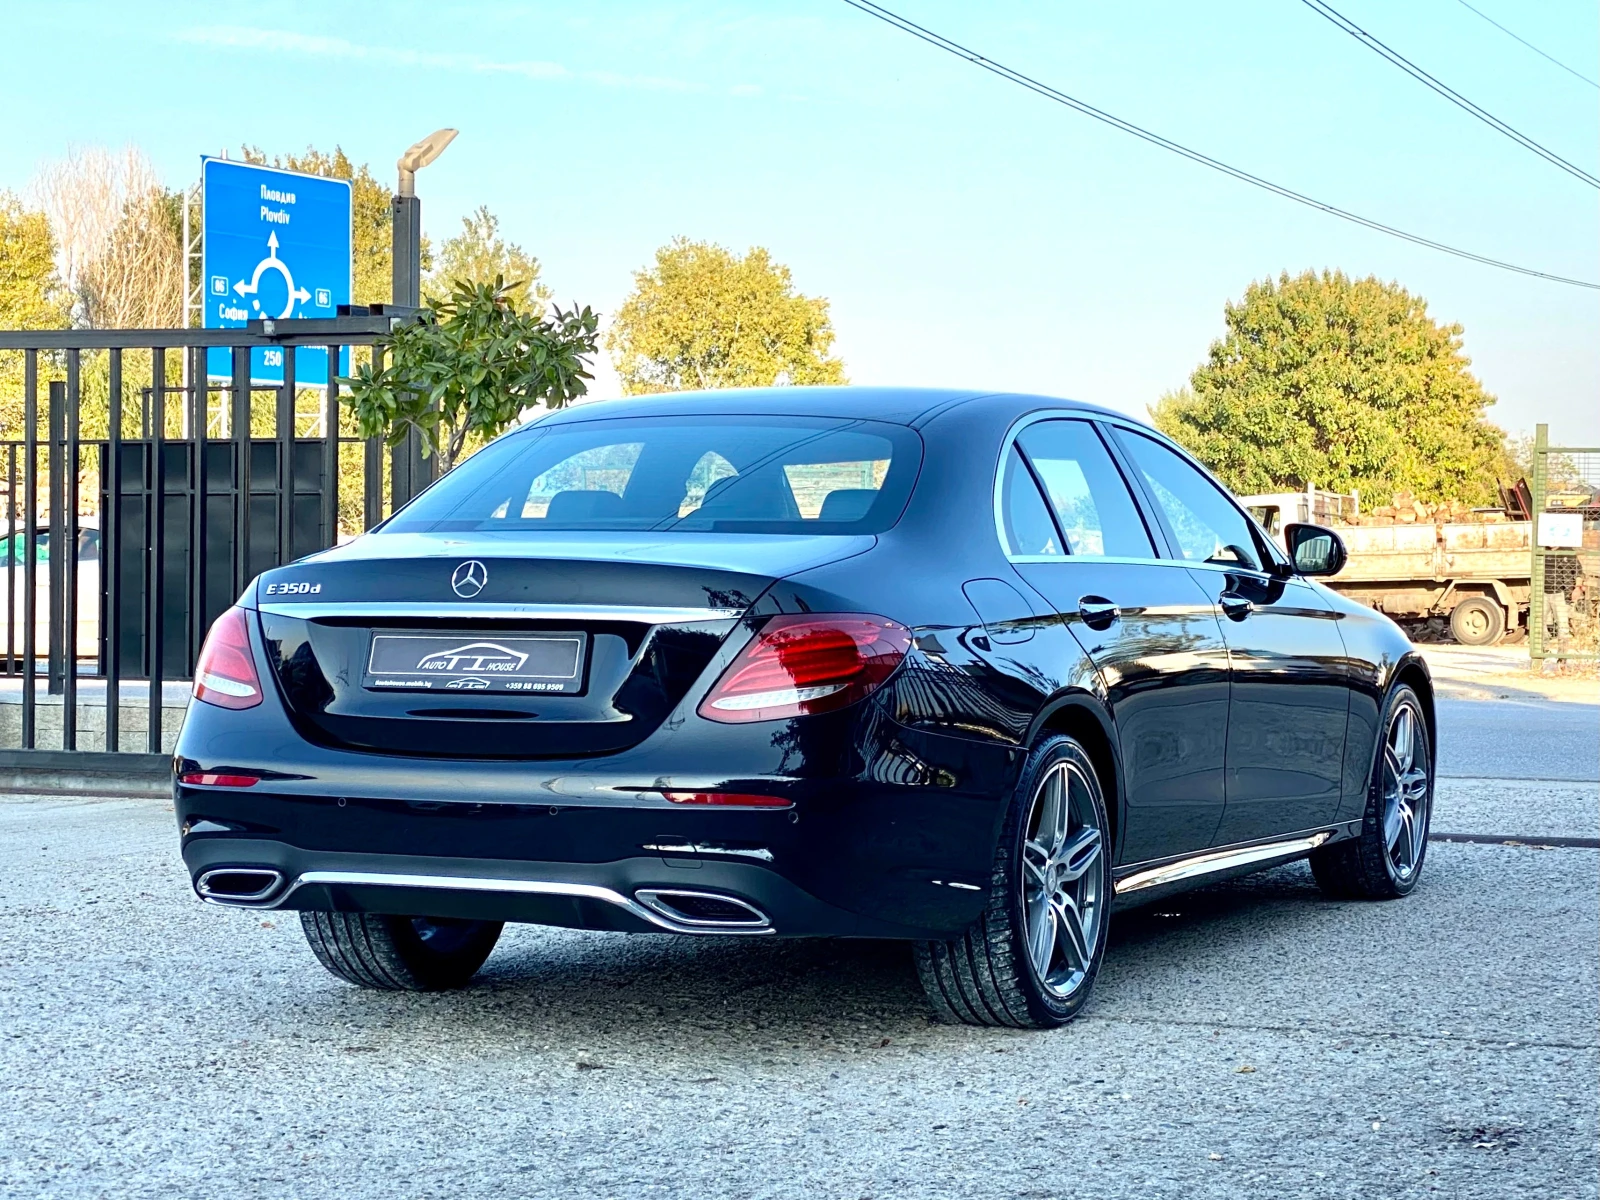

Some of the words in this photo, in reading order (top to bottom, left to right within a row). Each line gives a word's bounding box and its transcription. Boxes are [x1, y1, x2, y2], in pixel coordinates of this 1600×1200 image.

[261, 184, 296, 204] Пловдив
[261, 206, 290, 225] Plovdiv
[218, 302, 249, 322] София
[263, 350, 282, 367] 250
[422, 661, 447, 670] AUTO
[486, 662, 517, 672] HOUSE
[505, 682, 523, 690] +359
